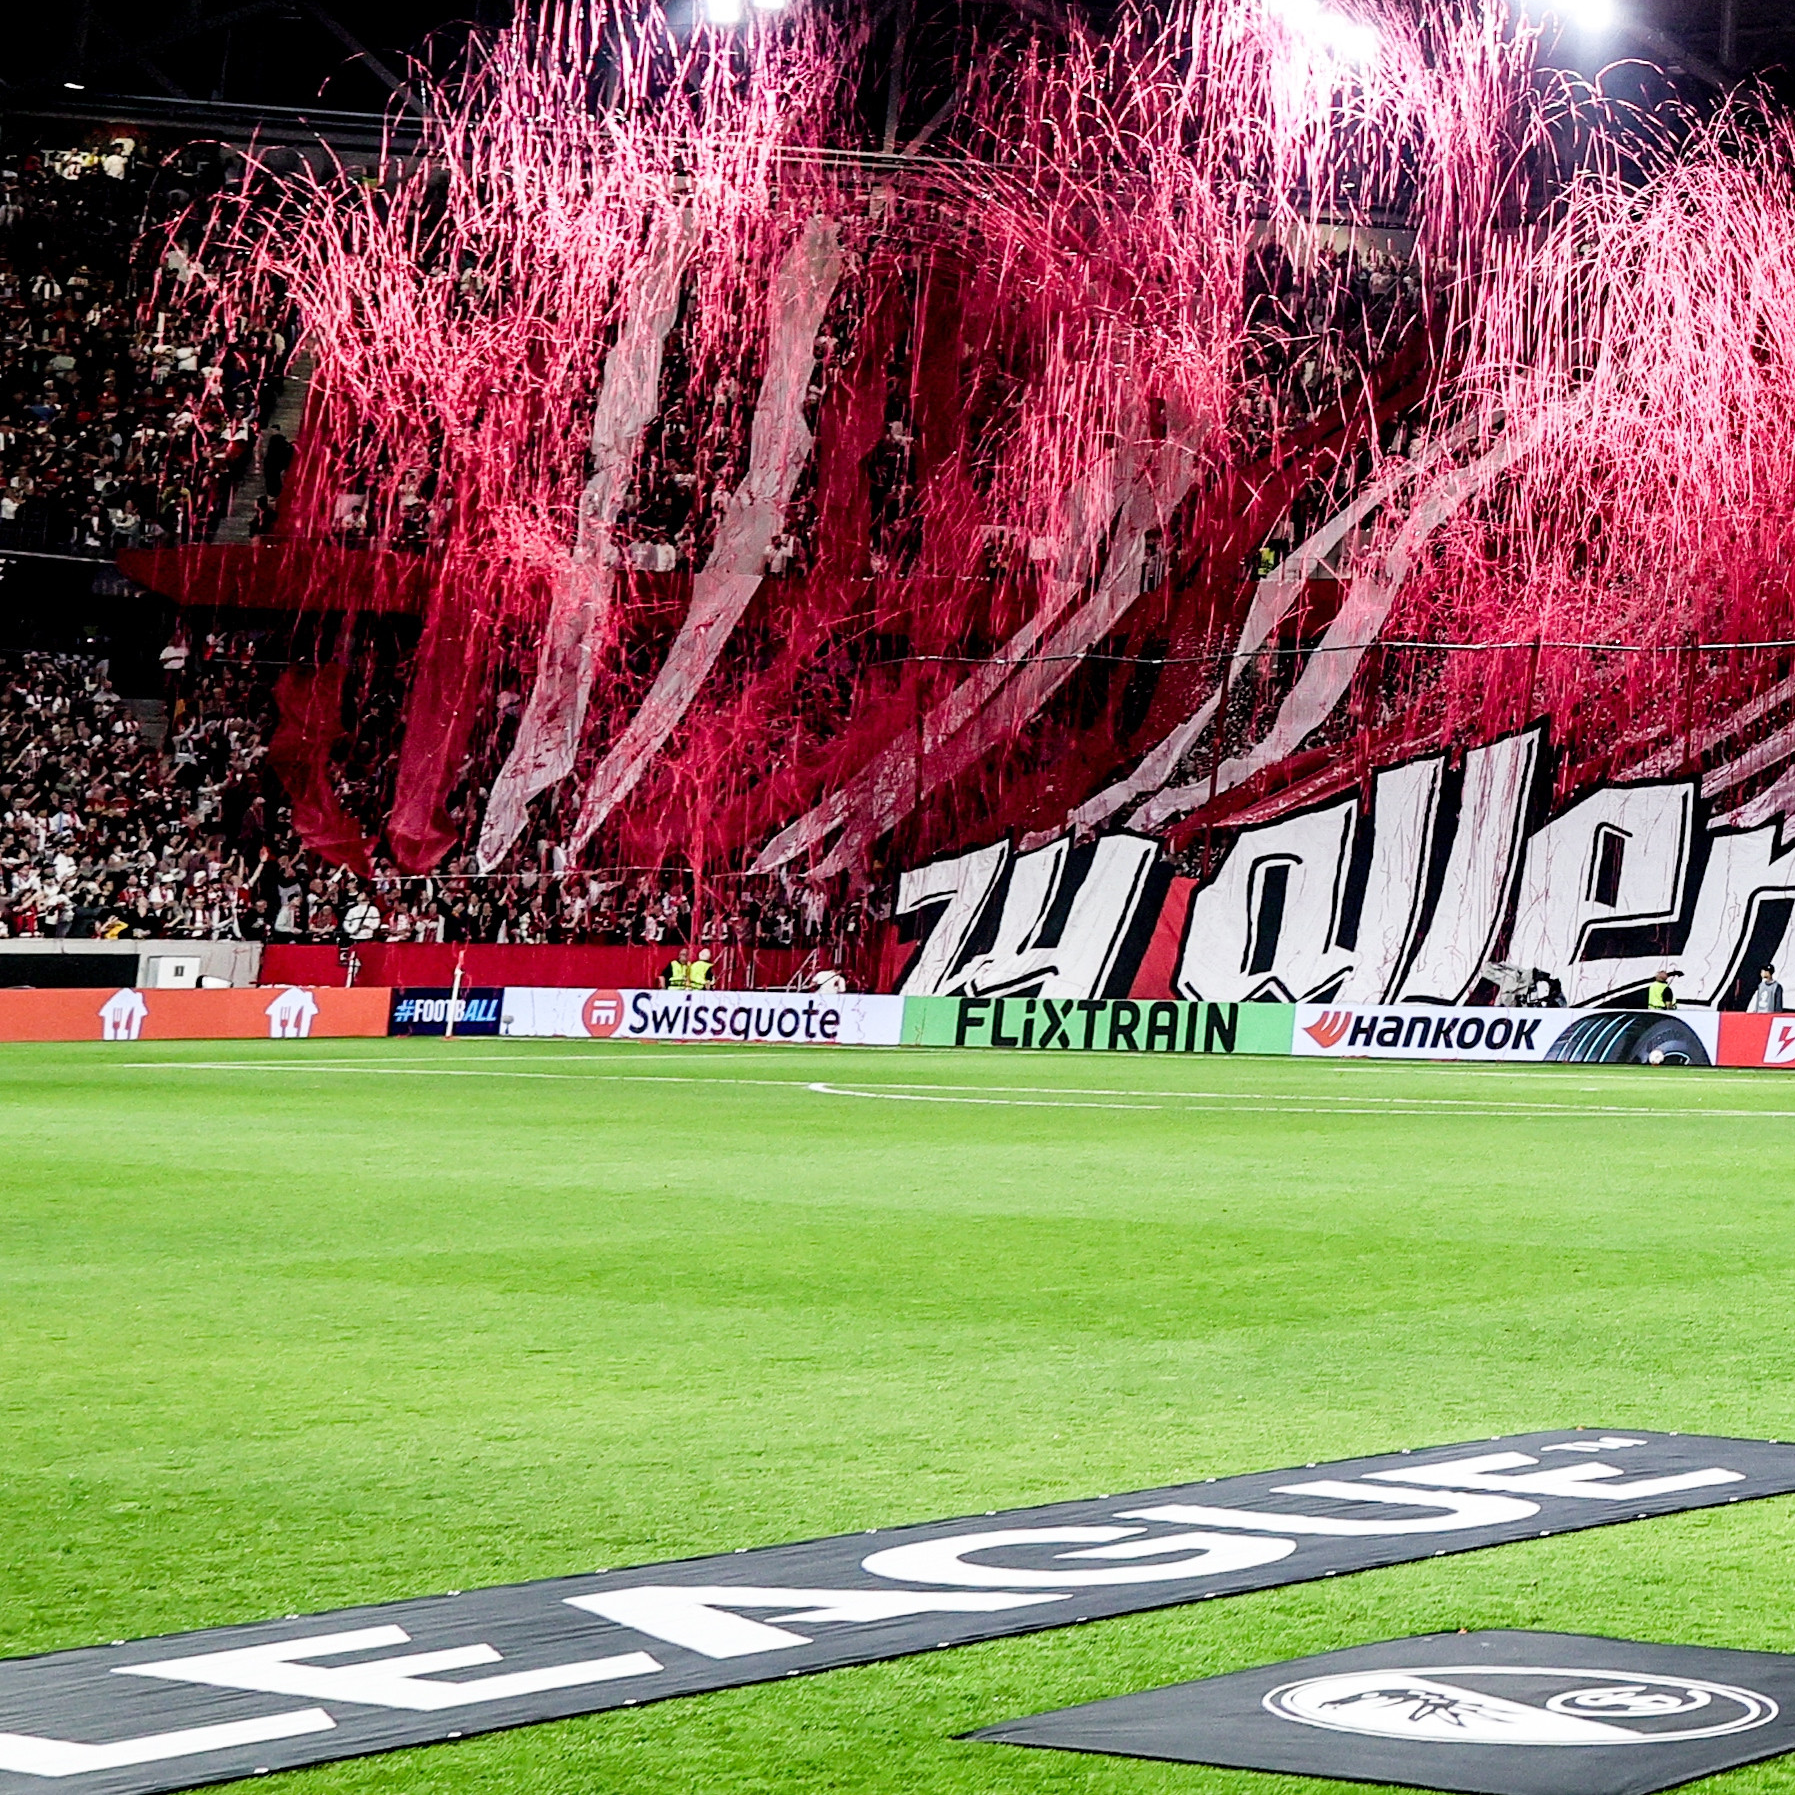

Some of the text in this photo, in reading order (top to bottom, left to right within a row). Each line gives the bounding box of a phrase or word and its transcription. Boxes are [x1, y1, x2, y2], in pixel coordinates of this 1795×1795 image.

[393, 999, 499, 1022] #FOOTBALL
[628, 991, 841, 1041] Swissquote
[0, 1452, 1745, 1777] LEAGUE
